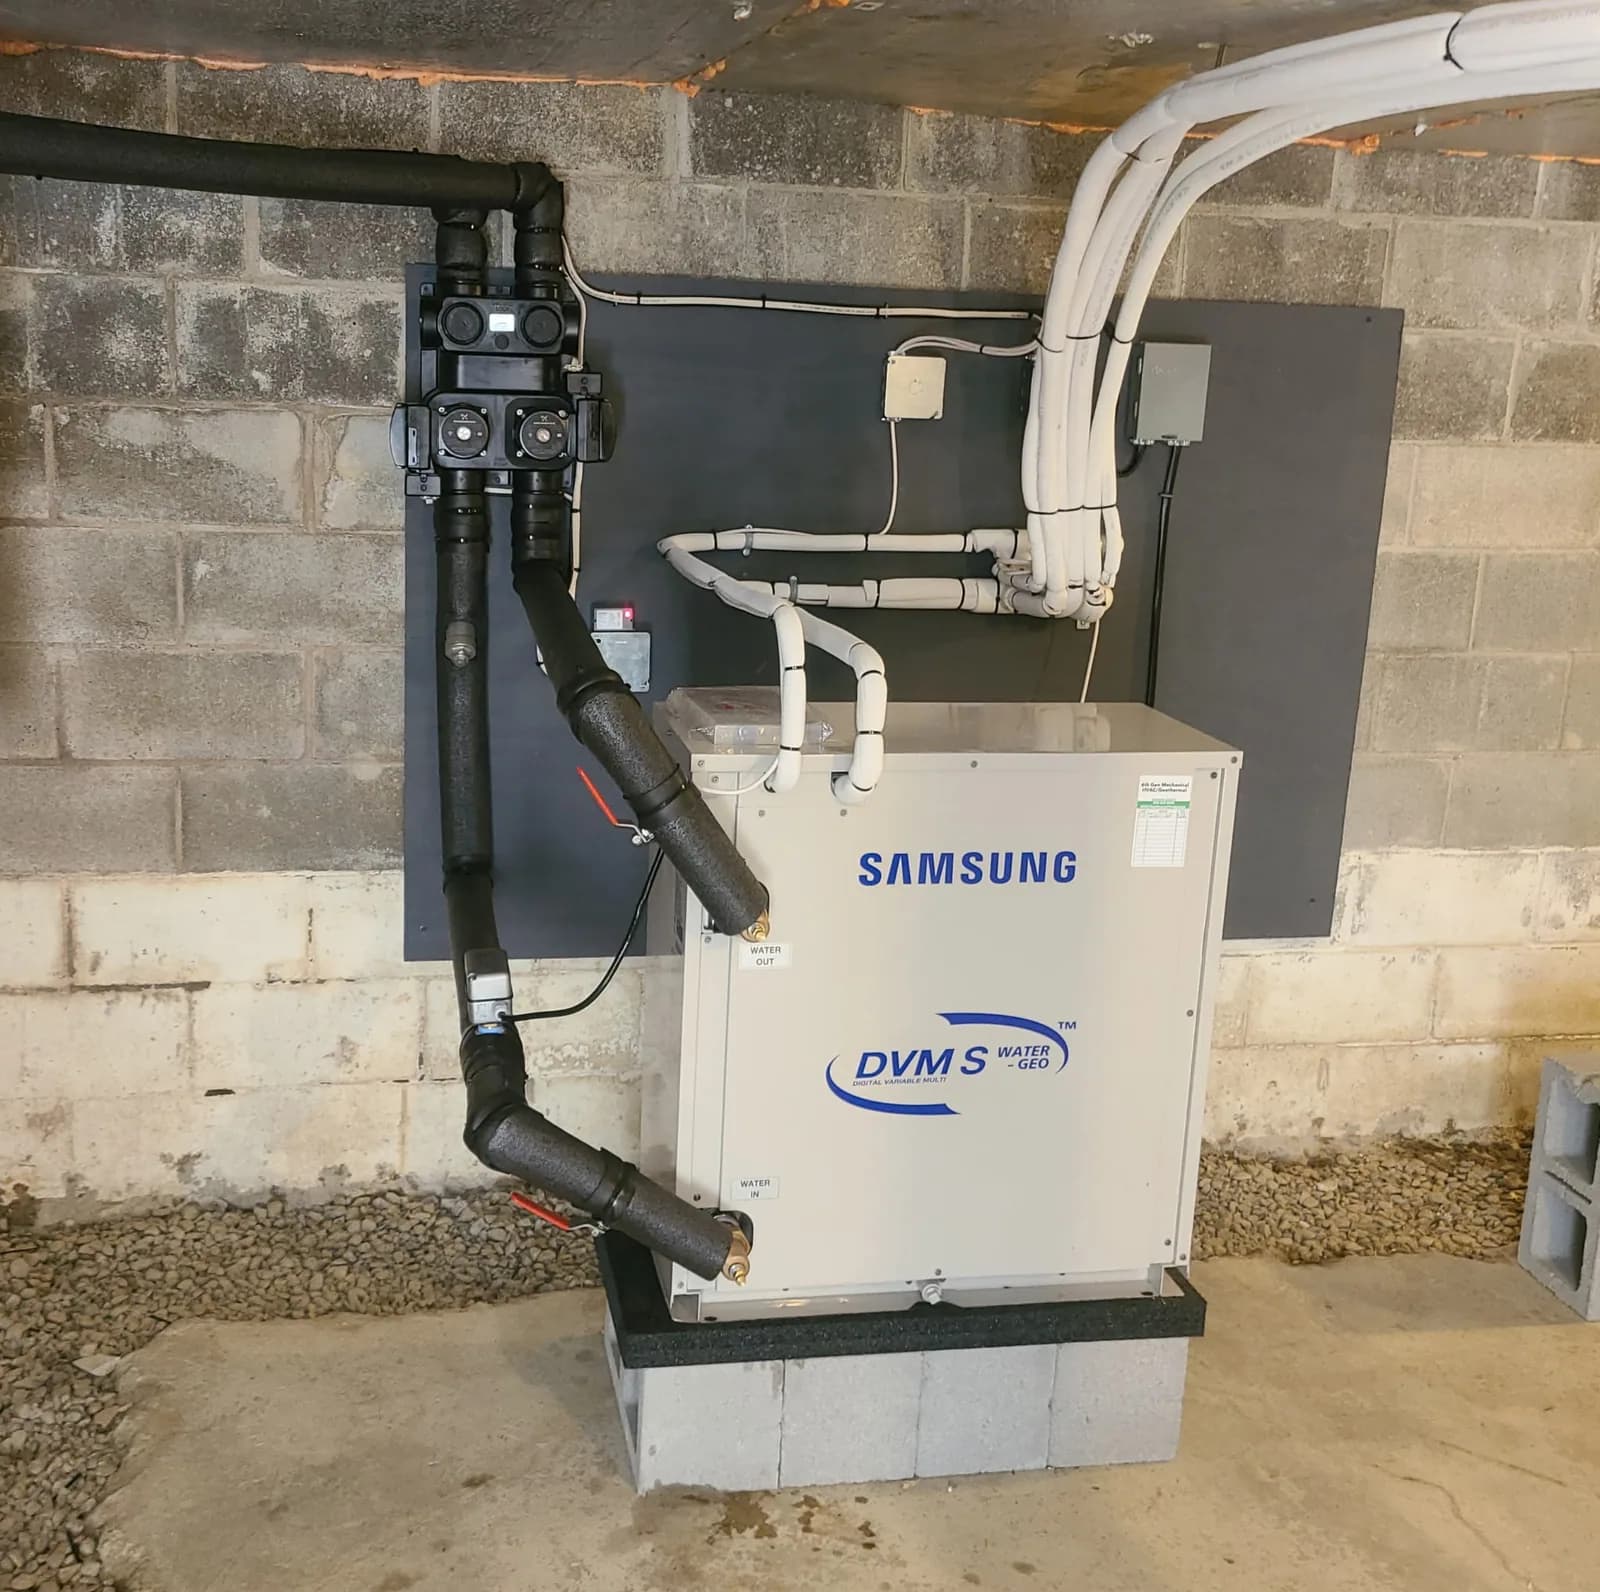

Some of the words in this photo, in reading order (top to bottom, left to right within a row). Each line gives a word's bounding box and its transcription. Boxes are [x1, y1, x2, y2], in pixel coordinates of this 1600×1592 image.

[858, 850, 1077, 886] SAMSUNG
[750, 946, 781, 954] WATER
[756, 958, 775, 966] OUT
[1058, 1021, 1077, 1030] TM
[997, 1045, 1050, 1058] WATER
[855, 1048, 955, 1079] DVM
[960, 1046, 988, 1076] S
[1018, 1058, 1050, 1070] GEO
[852, 1079, 882, 1087] DIGITAL
[740, 1179, 770, 1188] WATER
[750, 1191, 760, 1199] IN
